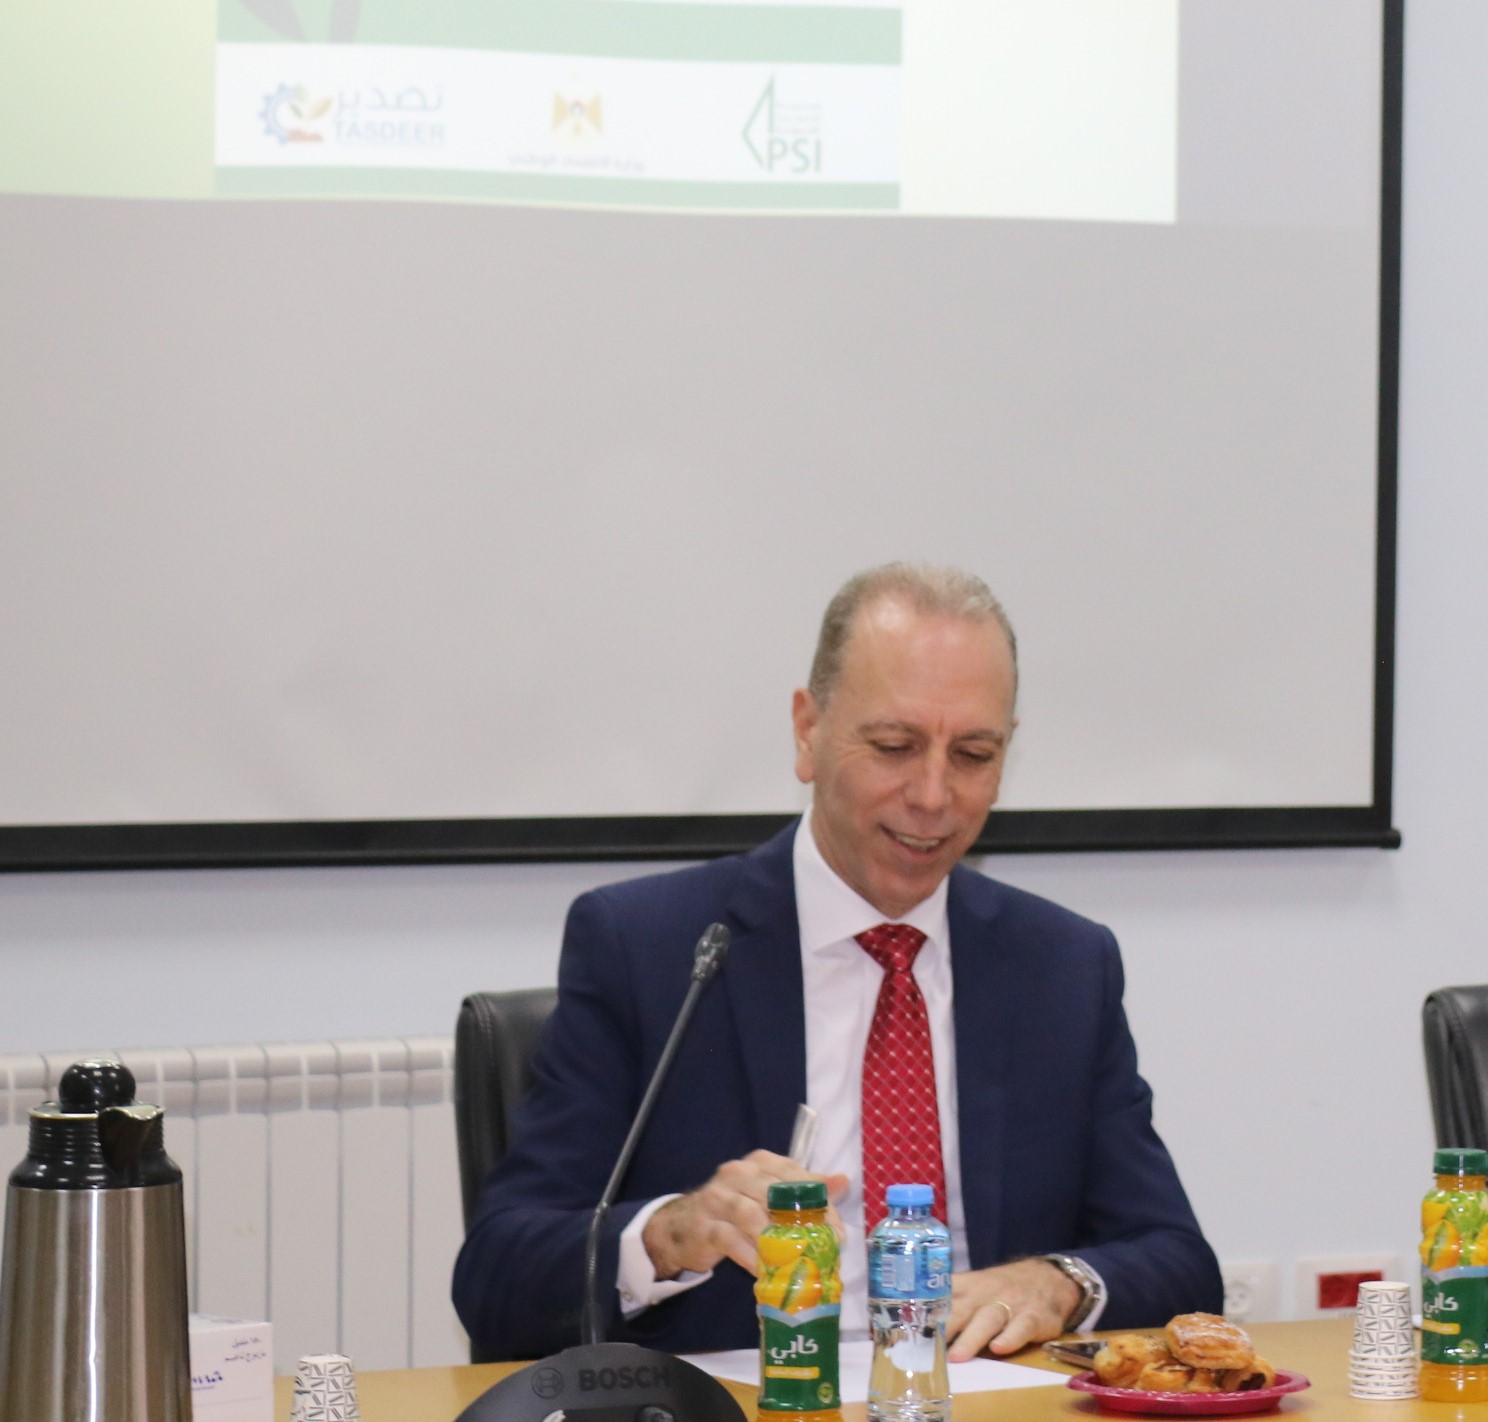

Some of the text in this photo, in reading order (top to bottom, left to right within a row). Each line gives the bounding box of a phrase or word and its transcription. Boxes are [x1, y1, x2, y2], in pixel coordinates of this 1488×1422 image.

[335, 120, 446, 140] TASDEER
[766, 137, 822, 173] PSI
[1423, 1292, 1459, 1318] كابي
[770, 1334, 819, 1365] كابي
[577, 1365, 671, 1393] BOSCH
